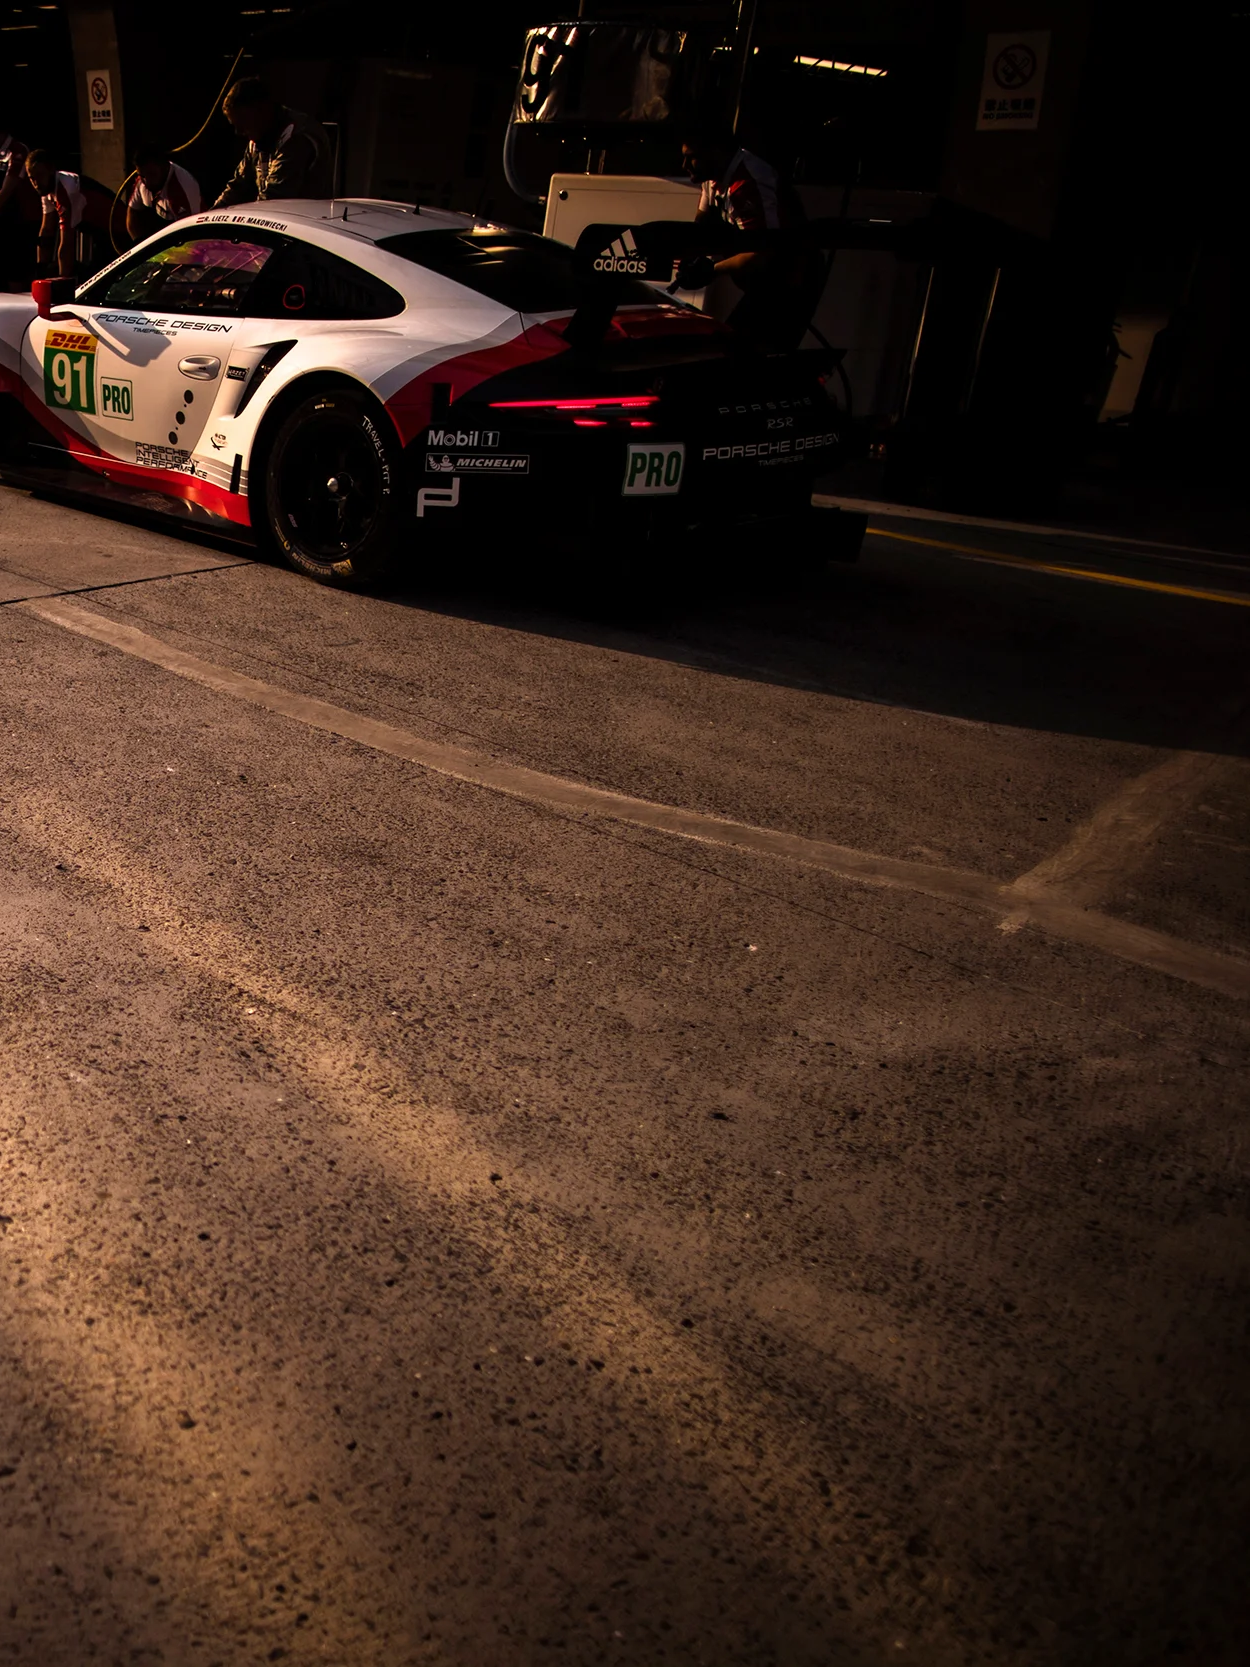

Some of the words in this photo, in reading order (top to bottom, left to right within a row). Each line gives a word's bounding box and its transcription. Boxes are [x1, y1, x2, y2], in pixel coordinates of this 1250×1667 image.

[246, 217, 288, 232] MAKOWIECKI
[593, 256, 647, 274] adidas
[97, 313, 168, 327] PORSCHE
[170, 320, 233, 333] DESIGN
[133, 327, 178, 336] TIMEPIECES
[50, 333, 91, 351] DHL
[51, 352, 88, 409] 91
[102, 384, 130, 415] PRO
[717, 396, 813, 416] PORSCHE
[766, 416, 794, 430] RSR
[362, 413, 385, 459] TRAVEL
[427, 430, 479, 447] Mobil
[135, 442, 190, 457] PORSCHE
[702, 440, 791, 461] PORSCHE
[794, 430, 840, 451] DESIGN
[136, 449, 200, 466] INTELLIGENT
[456, 458, 527, 468] MICHELIN
[758, 454, 804, 468] TIMEPIECES
[136, 456, 208, 479] PERFORMANCE
[627, 451, 681, 487] PRO
